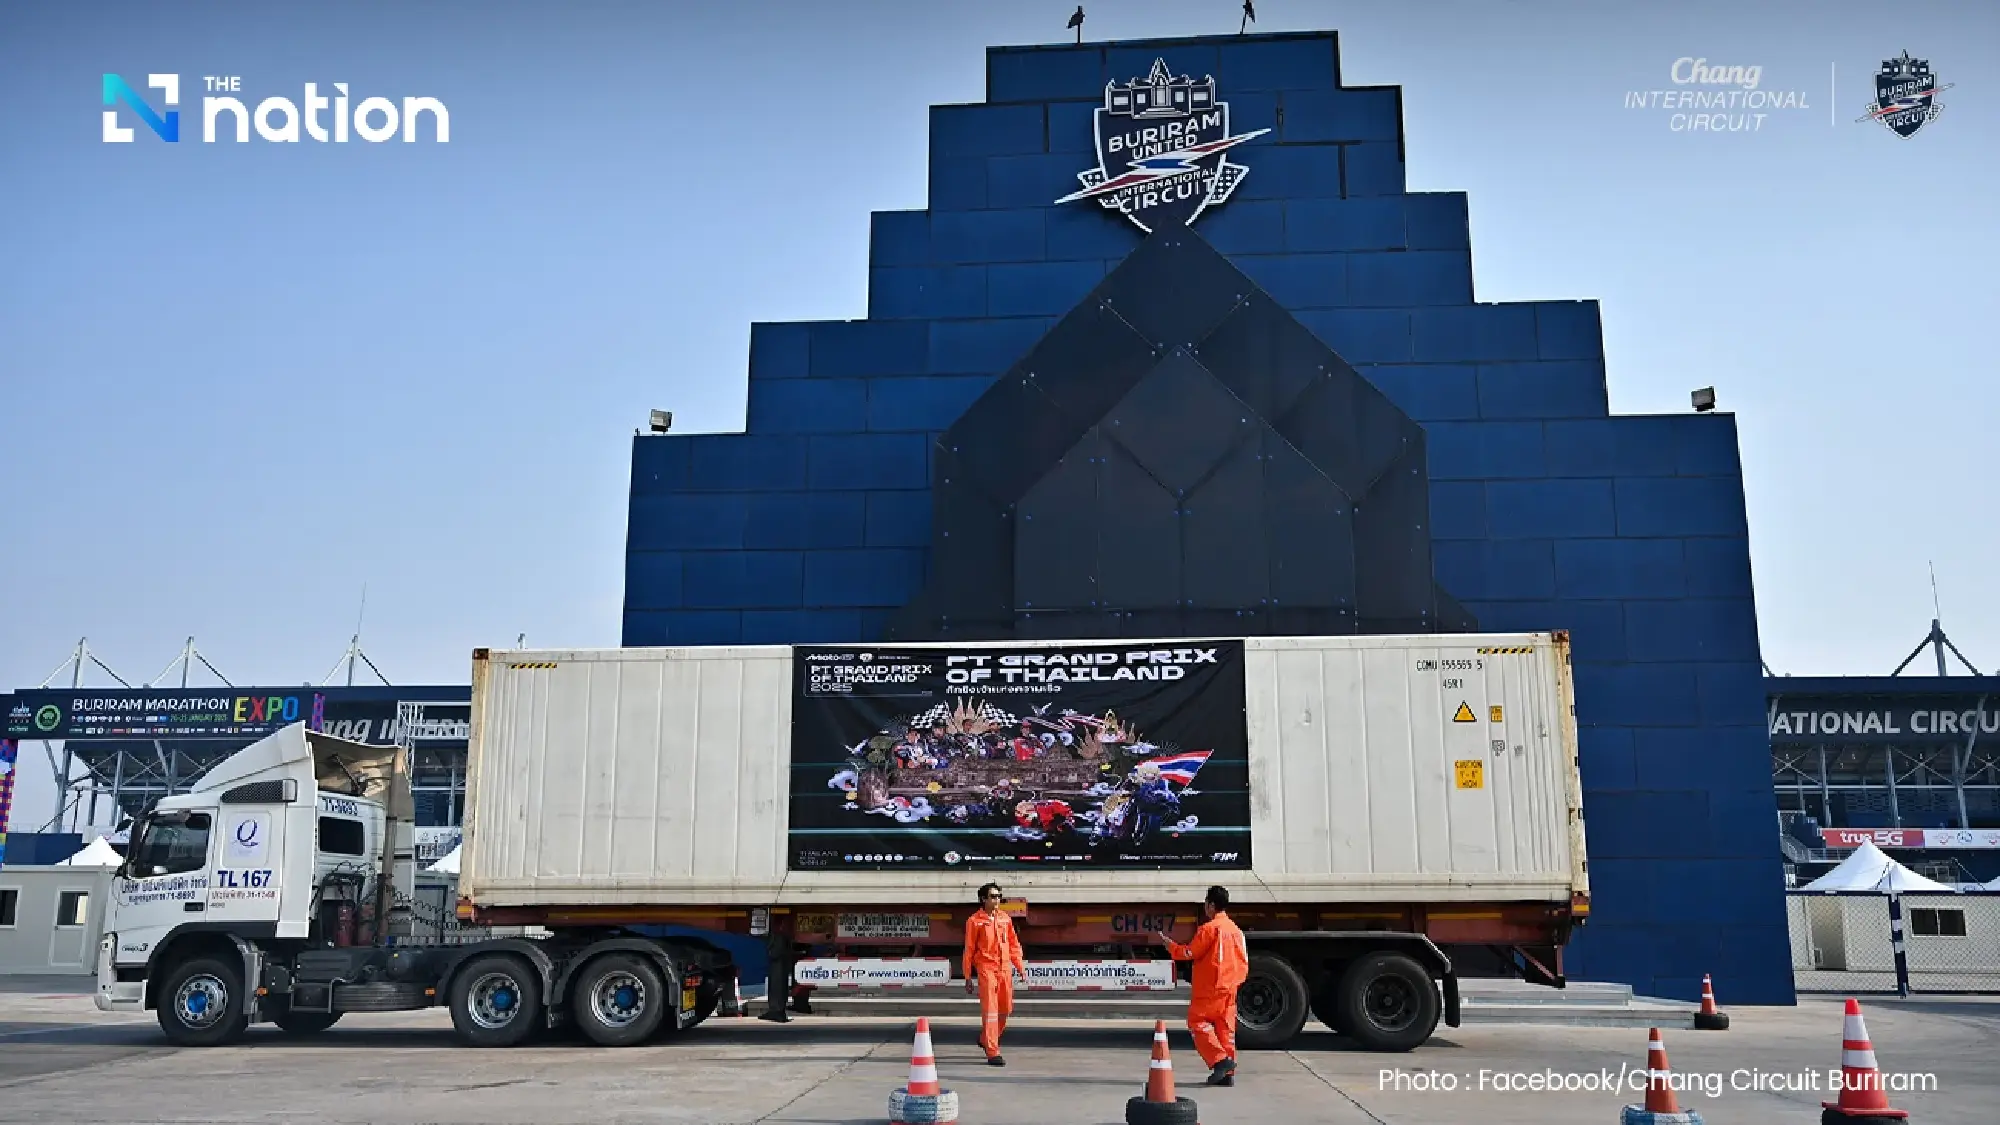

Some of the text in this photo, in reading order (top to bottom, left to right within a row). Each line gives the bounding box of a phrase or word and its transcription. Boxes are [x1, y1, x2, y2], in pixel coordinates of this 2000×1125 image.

[1108, 110, 1221, 153] BURIRAM
[1131, 133, 1199, 160] UNITED
[1119, 166, 1217, 198] INTERNATIONAL
[1119, 177, 1214, 214] CIRCUIT
[946, 648, 1217, 667] PT GRAND PRIX
[811, 673, 918, 683] OF THAILAND
[834, 665, 889, 674] GRAND
[891, 664, 932, 674] PRIX
[946, 665, 1185, 683] OF THAILAND
[72, 697, 230, 711] BURIRAM MARATHON
[233, 696, 299, 723] EXPO
[1771, 711, 1901, 734] ATIONAL
[217, 870, 272, 888] TL 167
[1112, 913, 1176, 932] CH 437
[868, 967, 944, 980] www.bmtp.co.th
